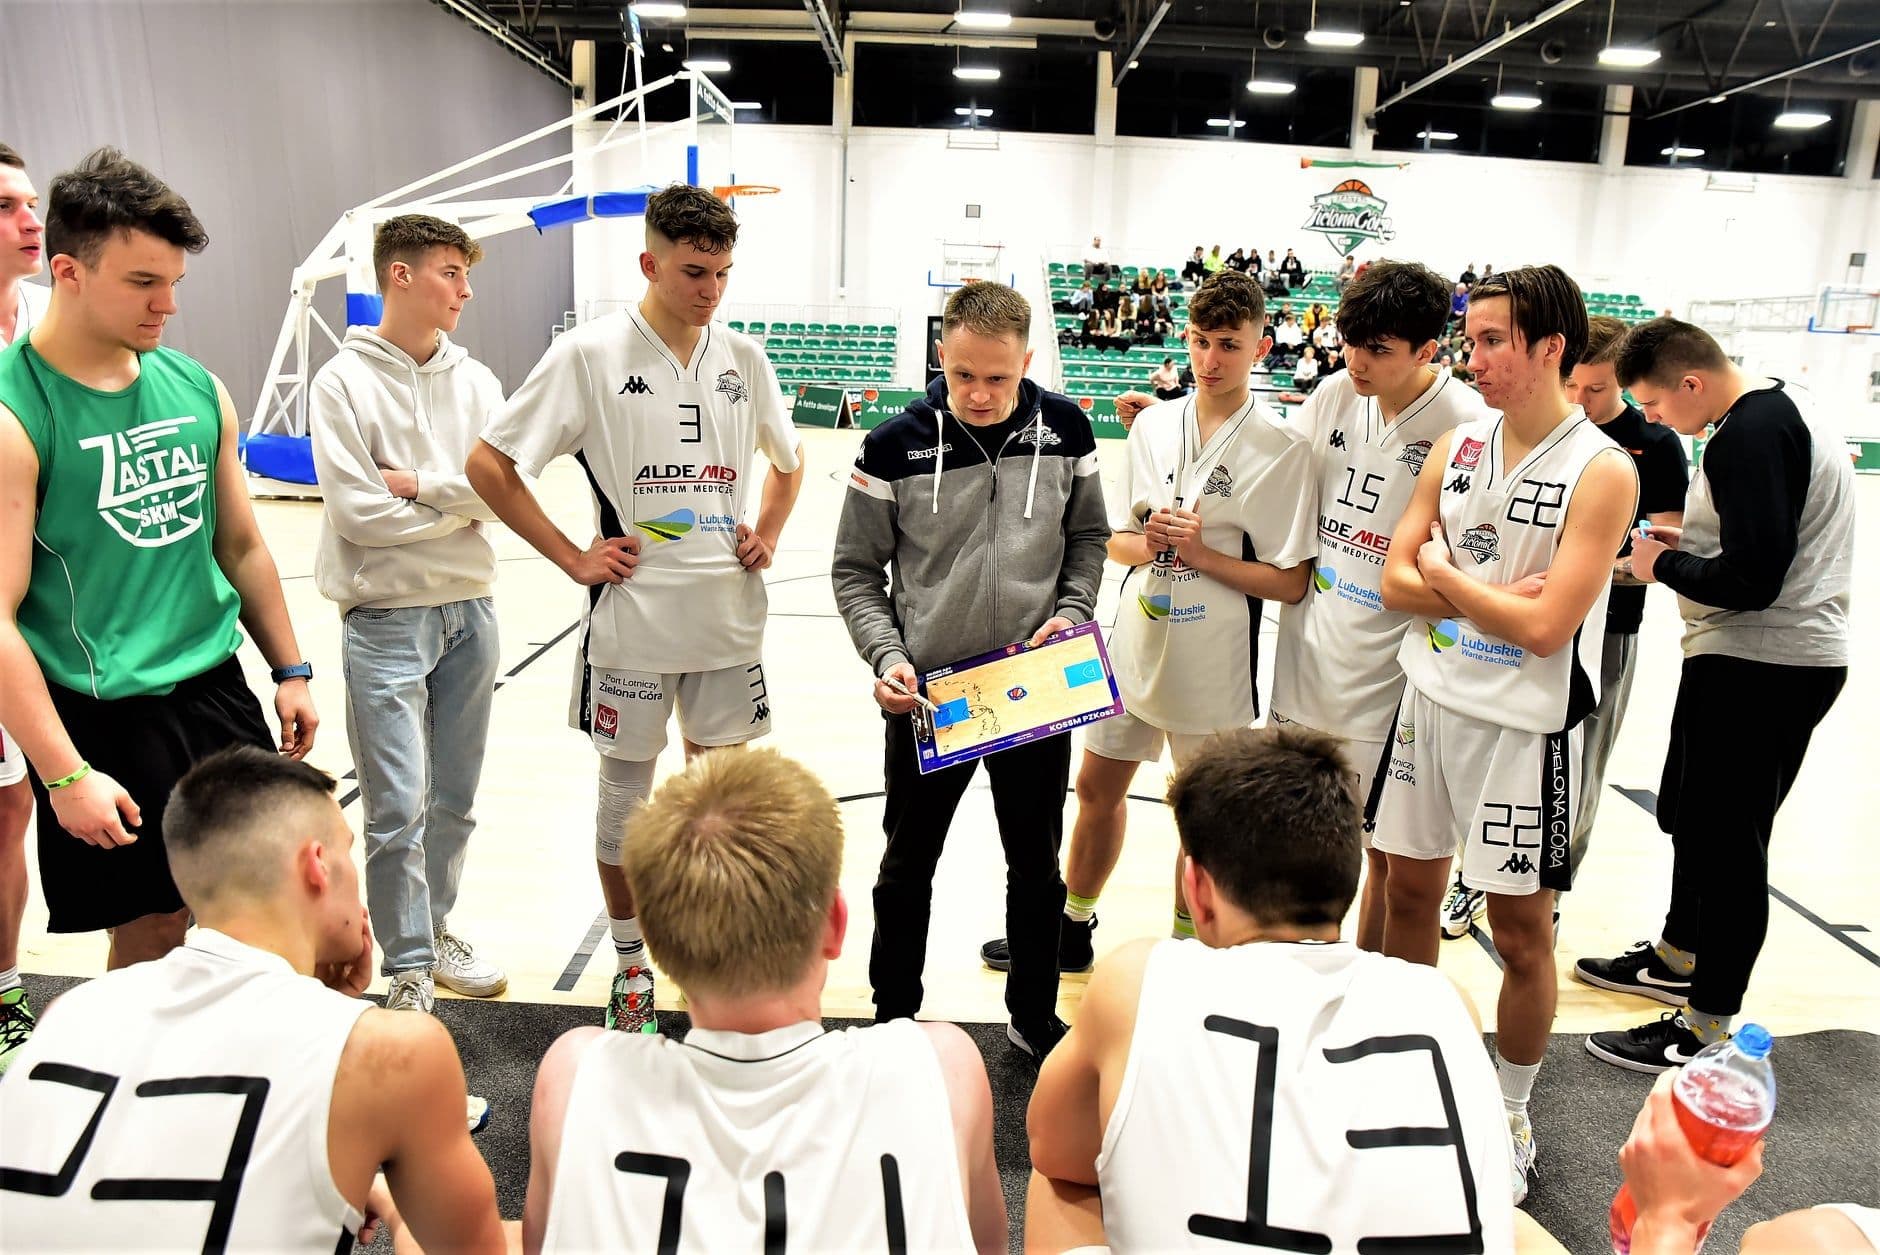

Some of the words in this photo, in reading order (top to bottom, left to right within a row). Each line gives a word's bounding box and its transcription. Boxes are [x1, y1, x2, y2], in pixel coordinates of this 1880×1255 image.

[882, 404, 906, 414] fatt
[1097, 413, 1120, 423] fatt
[678, 404, 701, 443] 3
[78, 434, 207, 510] ZASTAL
[633, 485, 687, 495] CENTRUM
[1336, 466, 1385, 514] 15
[1507, 478, 1567, 528] 22
[140, 501, 178, 528] SKM
[1171, 570, 1200, 583] DYCZNE
[1461, 635, 1523, 658] Lubuskie
[1461, 648, 1484, 661] Warte
[1483, 655, 1521, 667] zachodu
[599, 681, 636, 699] Zielona
[638, 690, 663, 701] Góra
[605, 674, 621, 684] Port
[622, 678, 659, 690] Lotniczy
[747, 664, 767, 702] 3
[1550, 738, 1568, 818] ZIELONA
[1483, 802, 1542, 848] 22
[1188, 1014, 1484, 1255] 13
